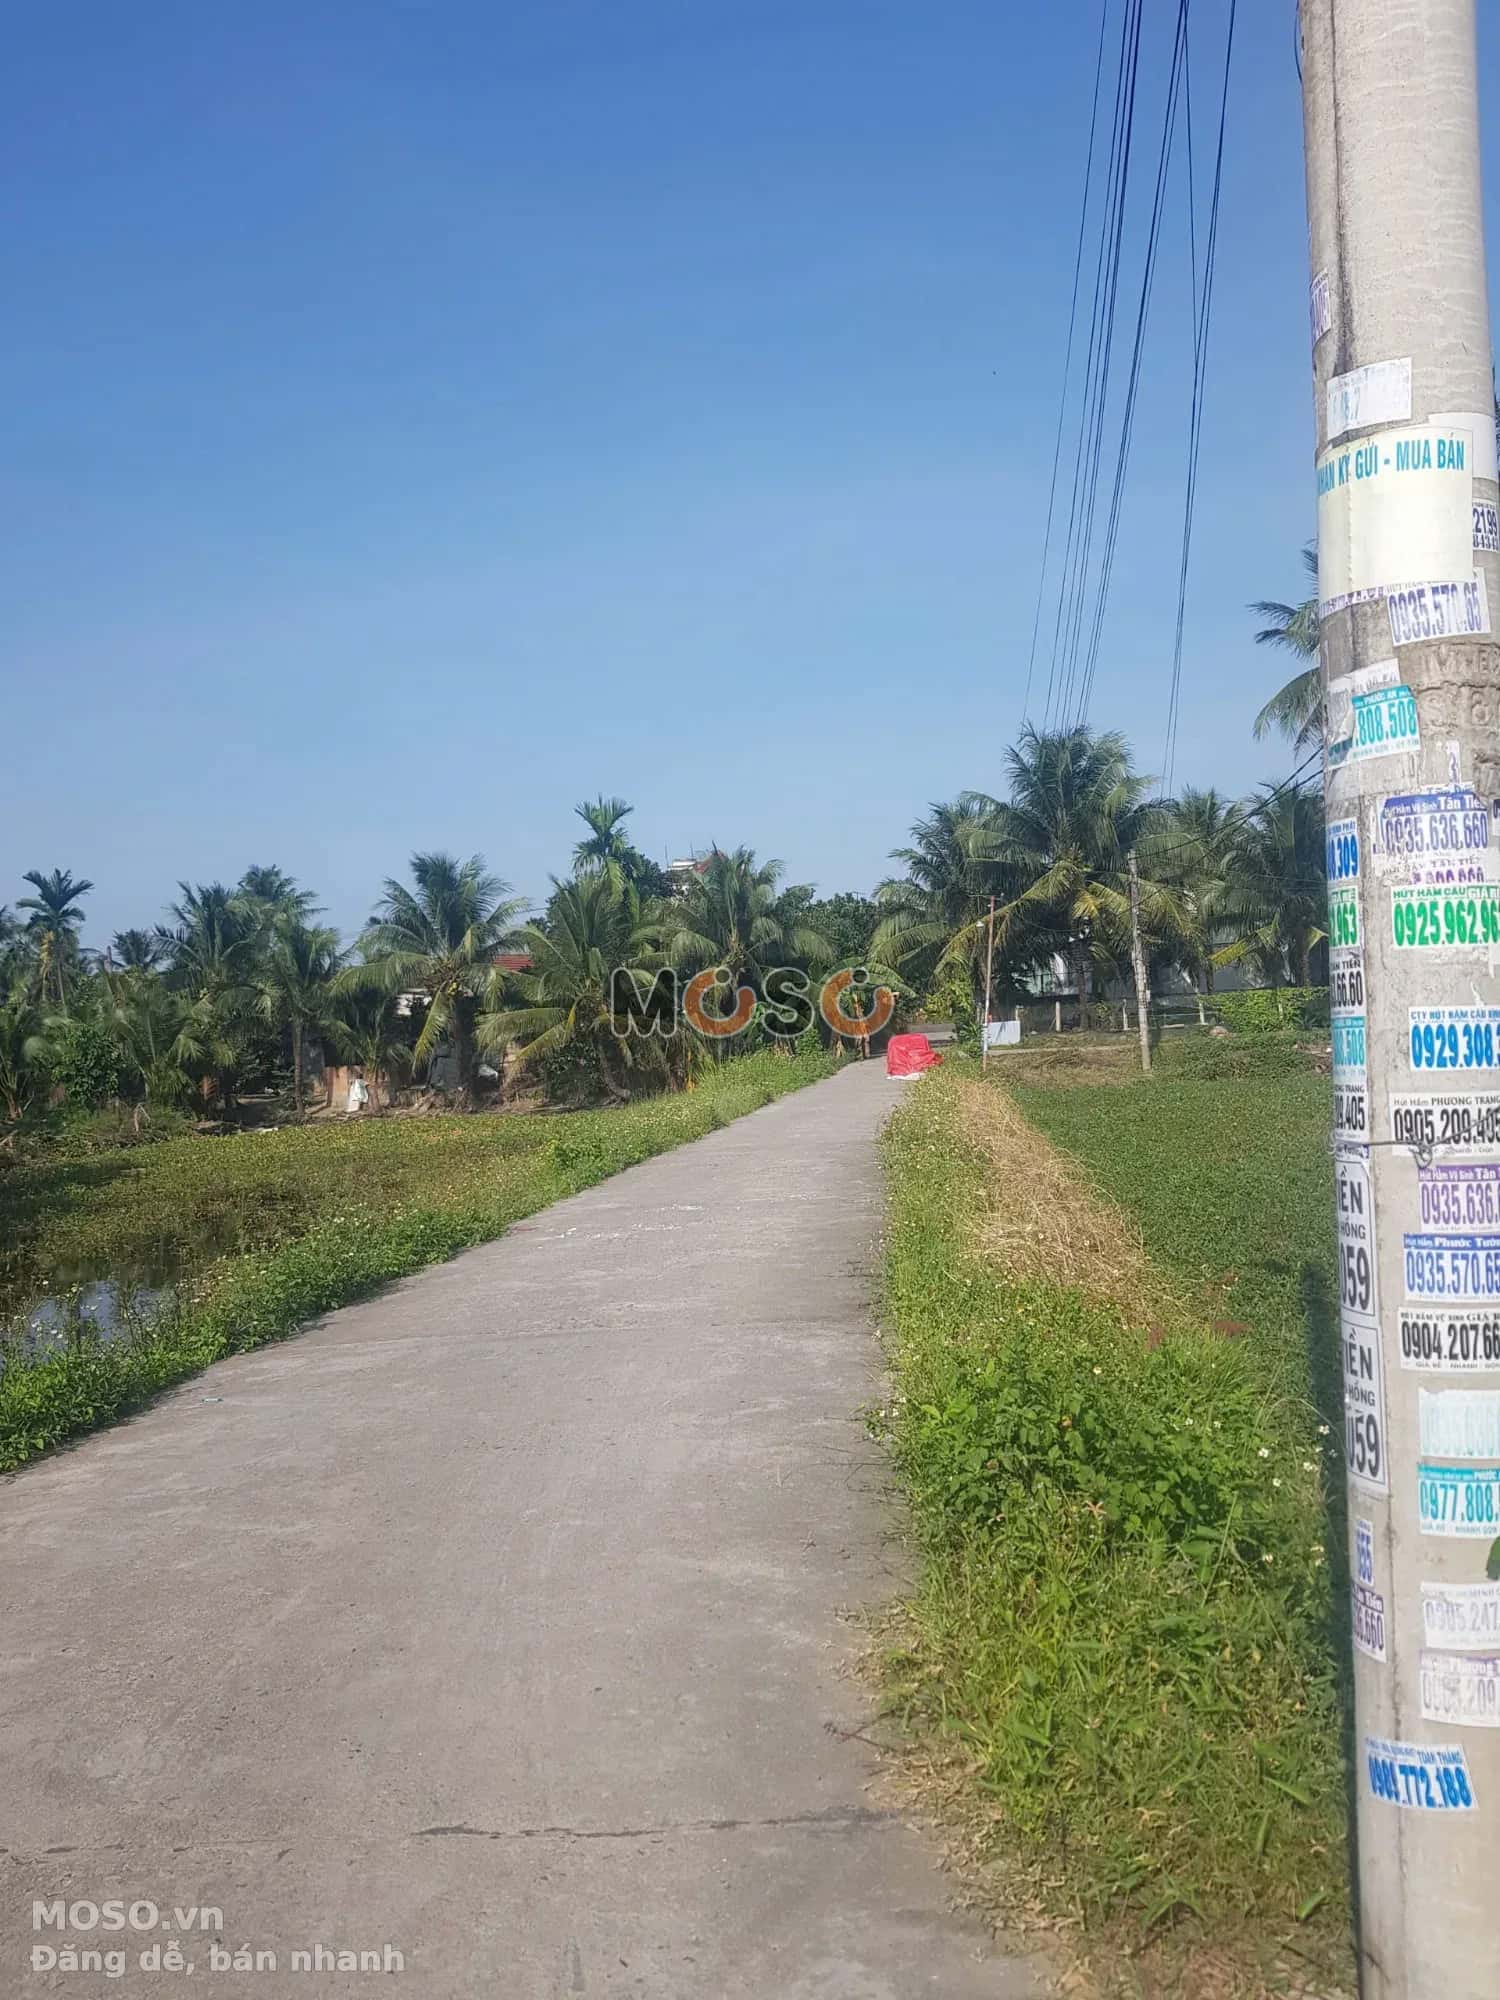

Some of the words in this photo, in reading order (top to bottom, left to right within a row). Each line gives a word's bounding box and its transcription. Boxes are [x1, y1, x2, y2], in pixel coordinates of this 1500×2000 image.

[1396, 439, 1432, 472] MUA
[1436, 432, 1465, 471] BÁN
[1394, 899, 1500, 947] 0925.962.96
[1421, 1182, 1500, 1225] 0935.636.
[1420, 1481, 1500, 1523] 0977.808.
